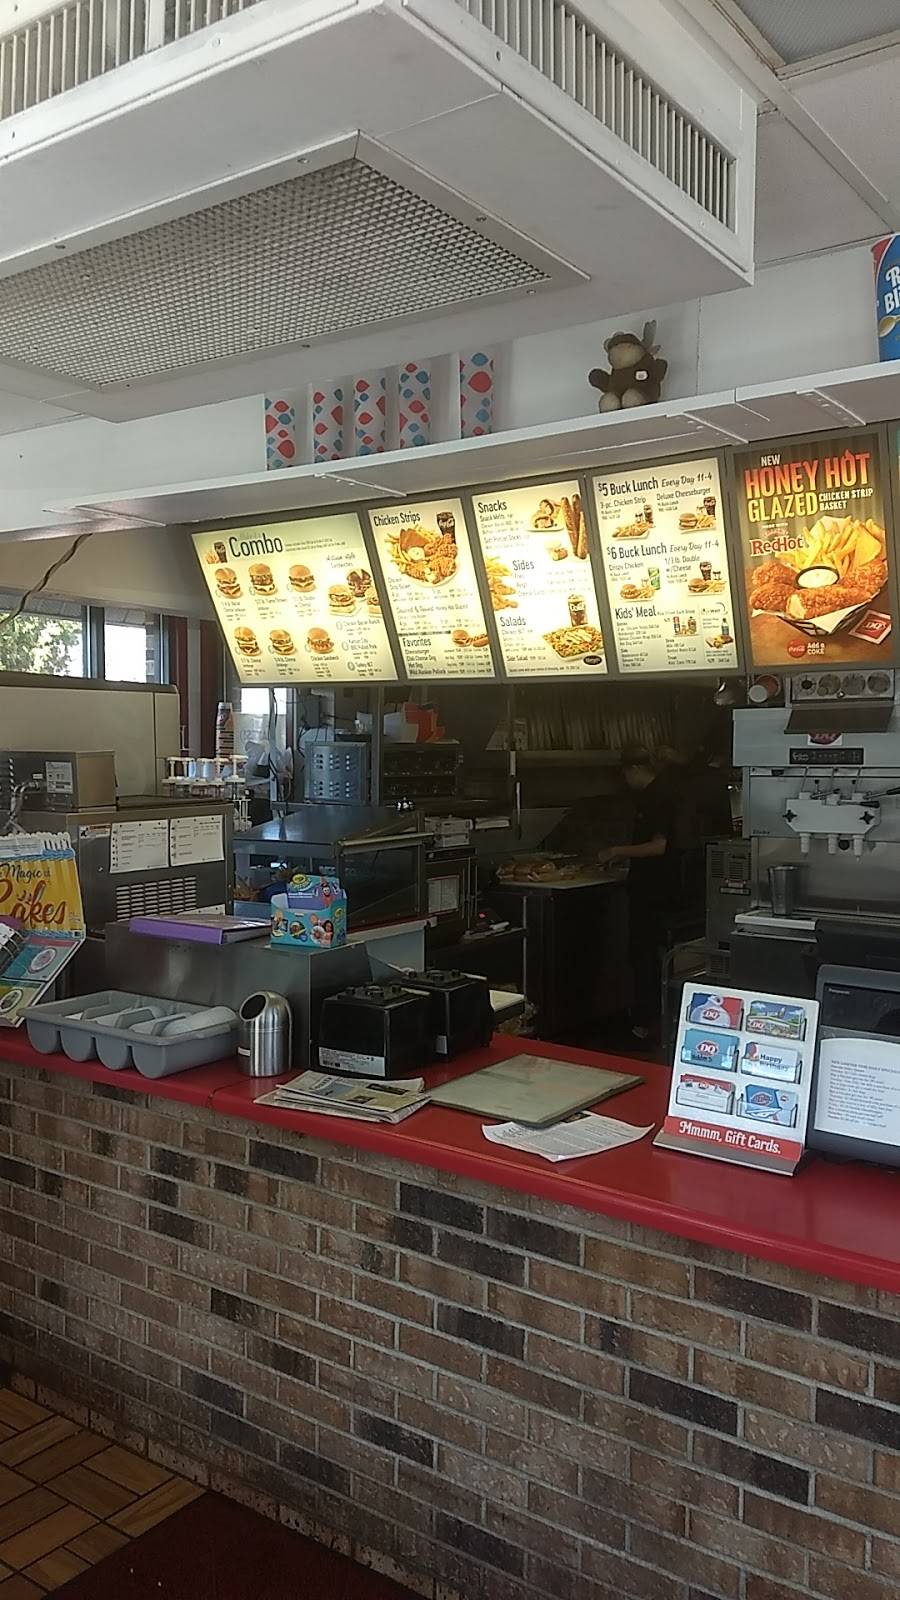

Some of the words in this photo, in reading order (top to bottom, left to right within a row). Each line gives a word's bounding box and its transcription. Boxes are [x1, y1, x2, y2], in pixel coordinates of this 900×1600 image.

[760, 454, 780, 467] NEW
[744, 459, 819, 499] HONEY
[824, 451, 870, 489] HOT
[598, 482, 608, 496] $5
[610, 480, 631, 496] Buck
[632, 476, 658, 492] Lunch
[661, 478, 680, 488] Every
[680, 475, 694, 485] Day
[697, 472, 712, 482] 11-4
[656, 492, 674, 500] Deluxe
[675, 487, 711, 498] Cheeseburger
[818, 490, 850, 502] CHICKEN
[851, 488, 874, 499] STRIP
[478, 500, 508, 514] Snacks
[613, 498, 633, 507] Chicken
[634, 496, 646, 504] Strip
[747, 492, 818, 523] GLAZED
[819, 500, 848, 511] BASKET
[374, 514, 400, 526] Chicken
[400, 511, 420, 524] Strips
[229, 532, 283, 557] Combo
[606, 546, 618, 560] $6
[619, 546, 640, 558] Buck
[641, 542, 667, 556] Lunch
[670, 544, 688, 553] Every
[688, 542, 702, 550] Day
[624, 561, 644, 569] Chicken
[682, 554, 700, 563] Double
[512, 560, 535, 571] Sides
[615, 606, 634, 620] Kids'
[635, 605, 657, 618] Meal
[500, 616, 526, 626] Salads
[402, 636, 432, 647] Favorites
[1, 863, 43, 884] Magic
[704, 1010, 718, 1018] DQ
[700, 1044, 717, 1054] DQ
[760, 1054, 782, 1064] Happy
[678, 1120, 722, 1142] Mmmm,
[725, 1131, 746, 1147] Gift
[747, 1136, 781, 1154] Cards.
